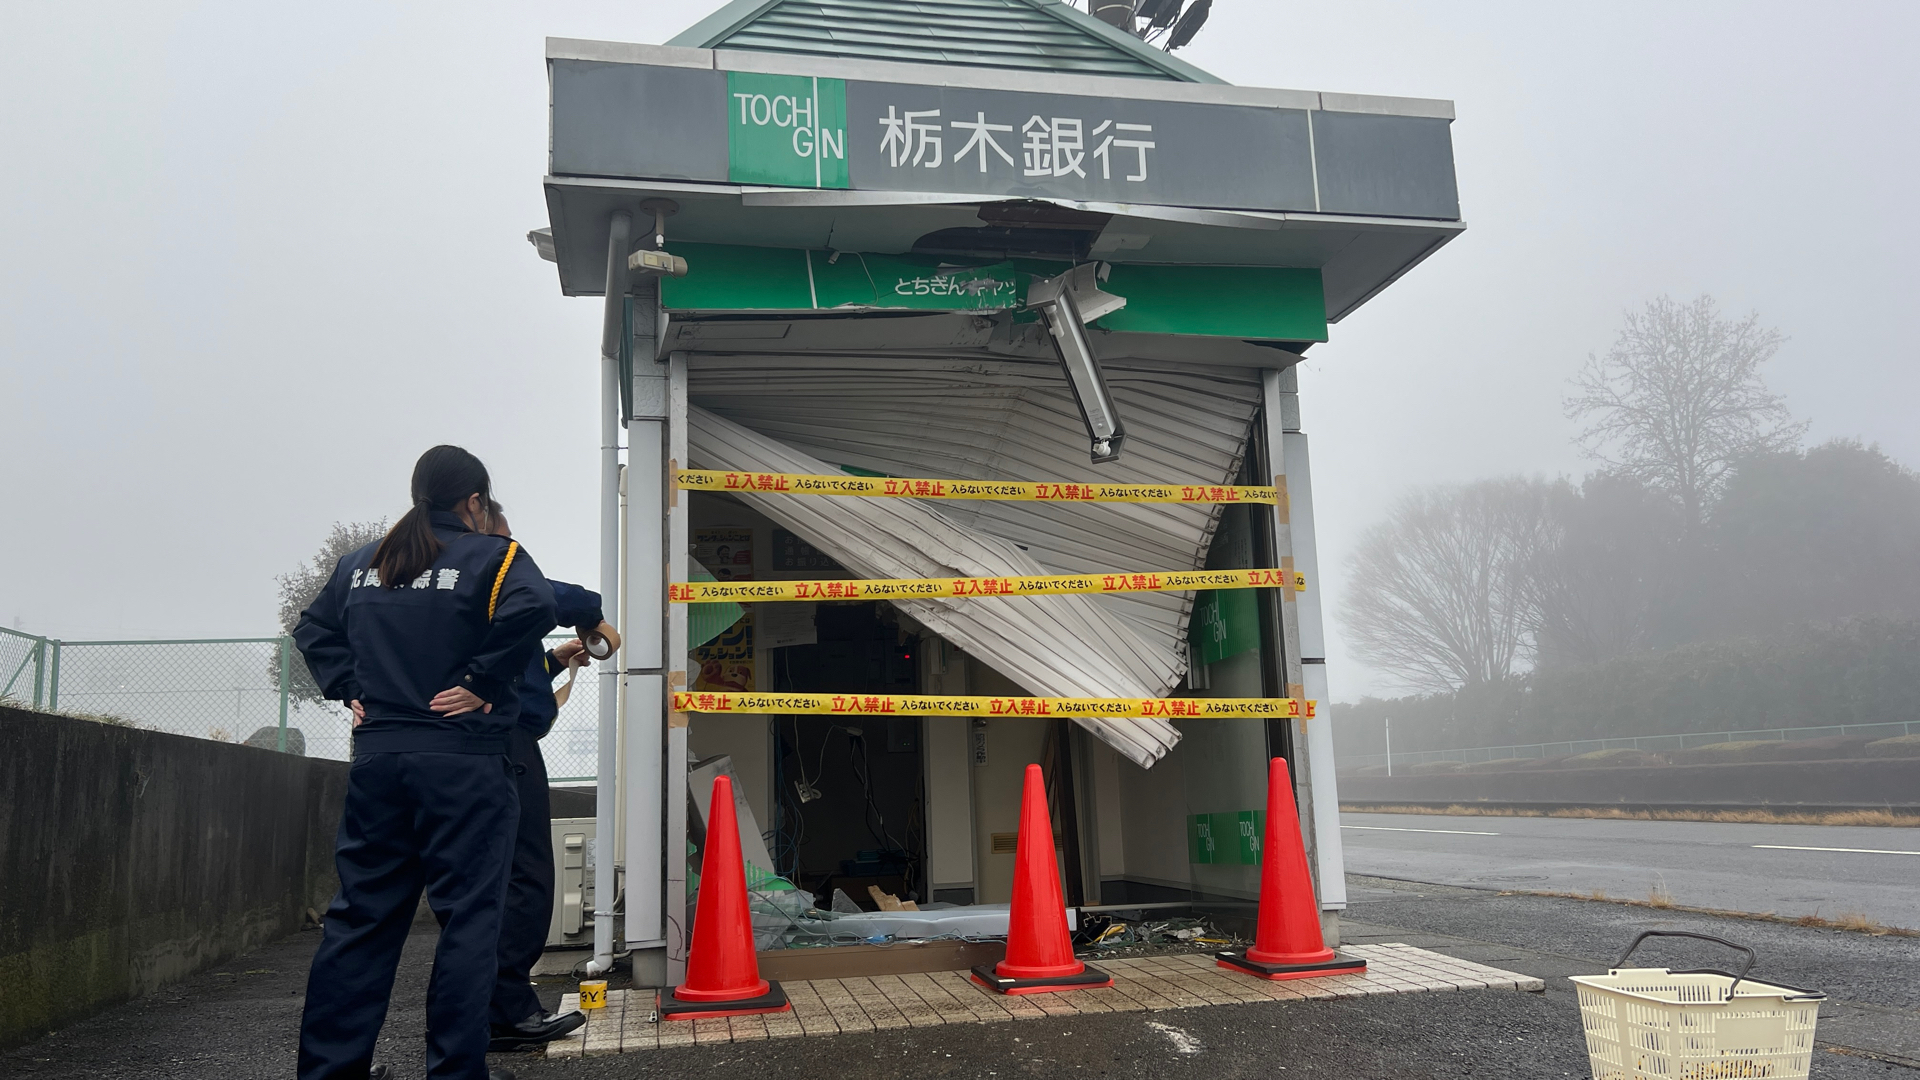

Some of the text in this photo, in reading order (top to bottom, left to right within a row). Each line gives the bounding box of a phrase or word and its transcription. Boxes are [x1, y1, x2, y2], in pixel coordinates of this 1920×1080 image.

[878, 104, 1157, 183] 栃木銀行
[724, 473, 790, 491] 立入禁止
[795, 478, 874, 491] 入らないでください
[884, 480, 946, 497] 立入禁止
[951, 484, 1026, 496] 入らないでください
[1035, 484, 1095, 500] 立入禁止
[1099, 488, 1172, 499] 入らないでください
[1181, 486, 1240, 502] 立入禁止
[701, 586, 784, 597] 入らないでください
[794, 582, 859, 599] 立入禁止
[864, 584, 943, 594] 入らないでください
[952, 578, 1014, 595] 立入禁止
[1018, 579, 1093, 591] 入らないでください
[1102, 574, 1162, 590] 立入禁止
[1166, 574, 1239, 586] 入らないでください
[737, 697, 821, 709] 入らないでください
[831, 696, 896, 713] 立入禁止
[900, 700, 980, 711] 入らないでください
[989, 699, 1051, 715] 立入禁止
[1056, 702, 1132, 713] 入らないでください
[1141, 700, 1201, 716] 立入禁止
[1205, 703, 1279, 713] 入らないでください
